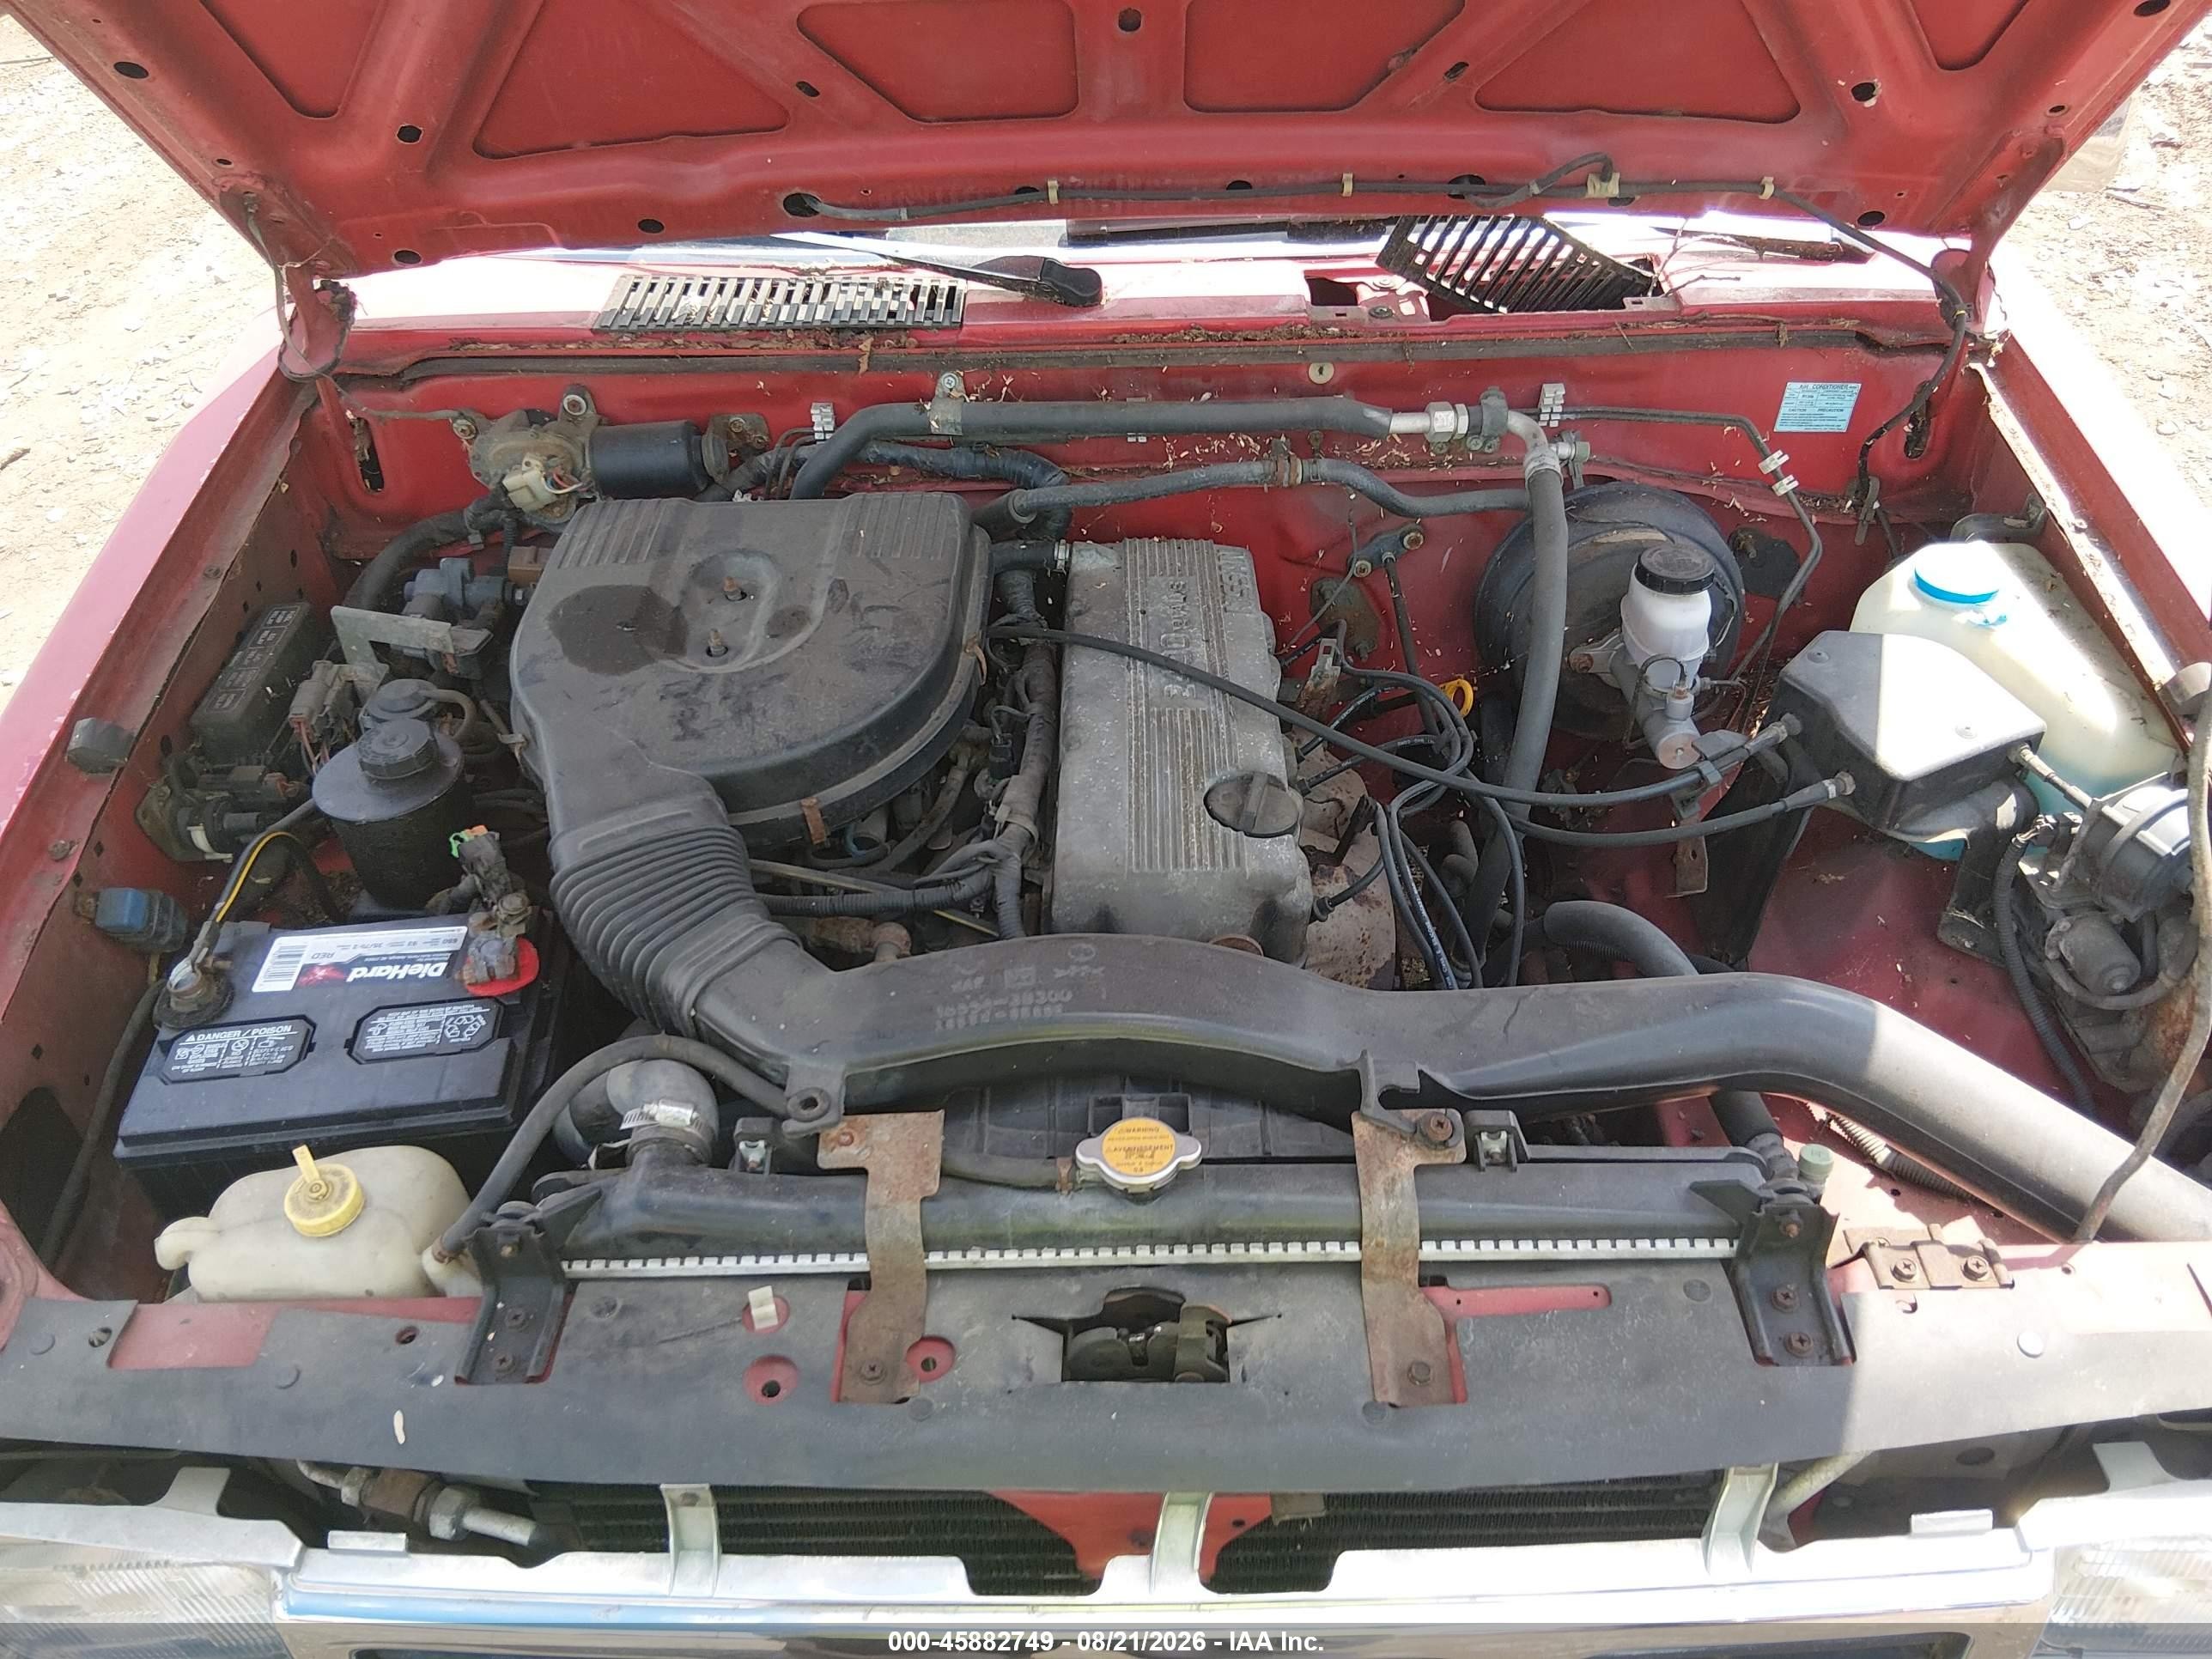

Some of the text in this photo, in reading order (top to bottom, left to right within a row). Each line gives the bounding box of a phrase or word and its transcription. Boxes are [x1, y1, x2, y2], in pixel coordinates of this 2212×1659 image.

[345, 961, 449, 983] DieHard
[197, 1030, 241, 1042] DANGER
[251, 1024, 292, 1036] POISON
